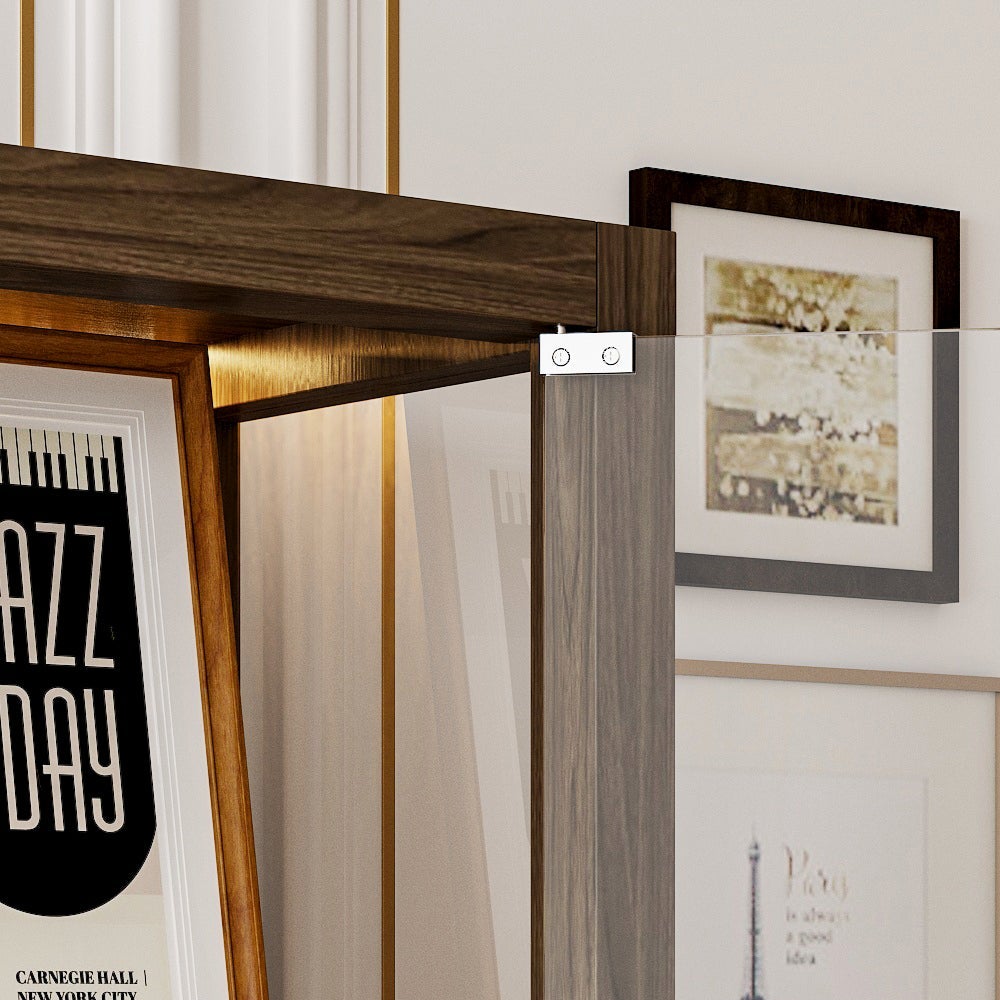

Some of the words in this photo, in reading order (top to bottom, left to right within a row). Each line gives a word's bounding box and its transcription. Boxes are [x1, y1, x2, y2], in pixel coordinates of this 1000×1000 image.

[0, 684, 125, 833] DAY
[15, 970, 95, 985] CARNEGIE
[97, 970, 138, 985] HALL
